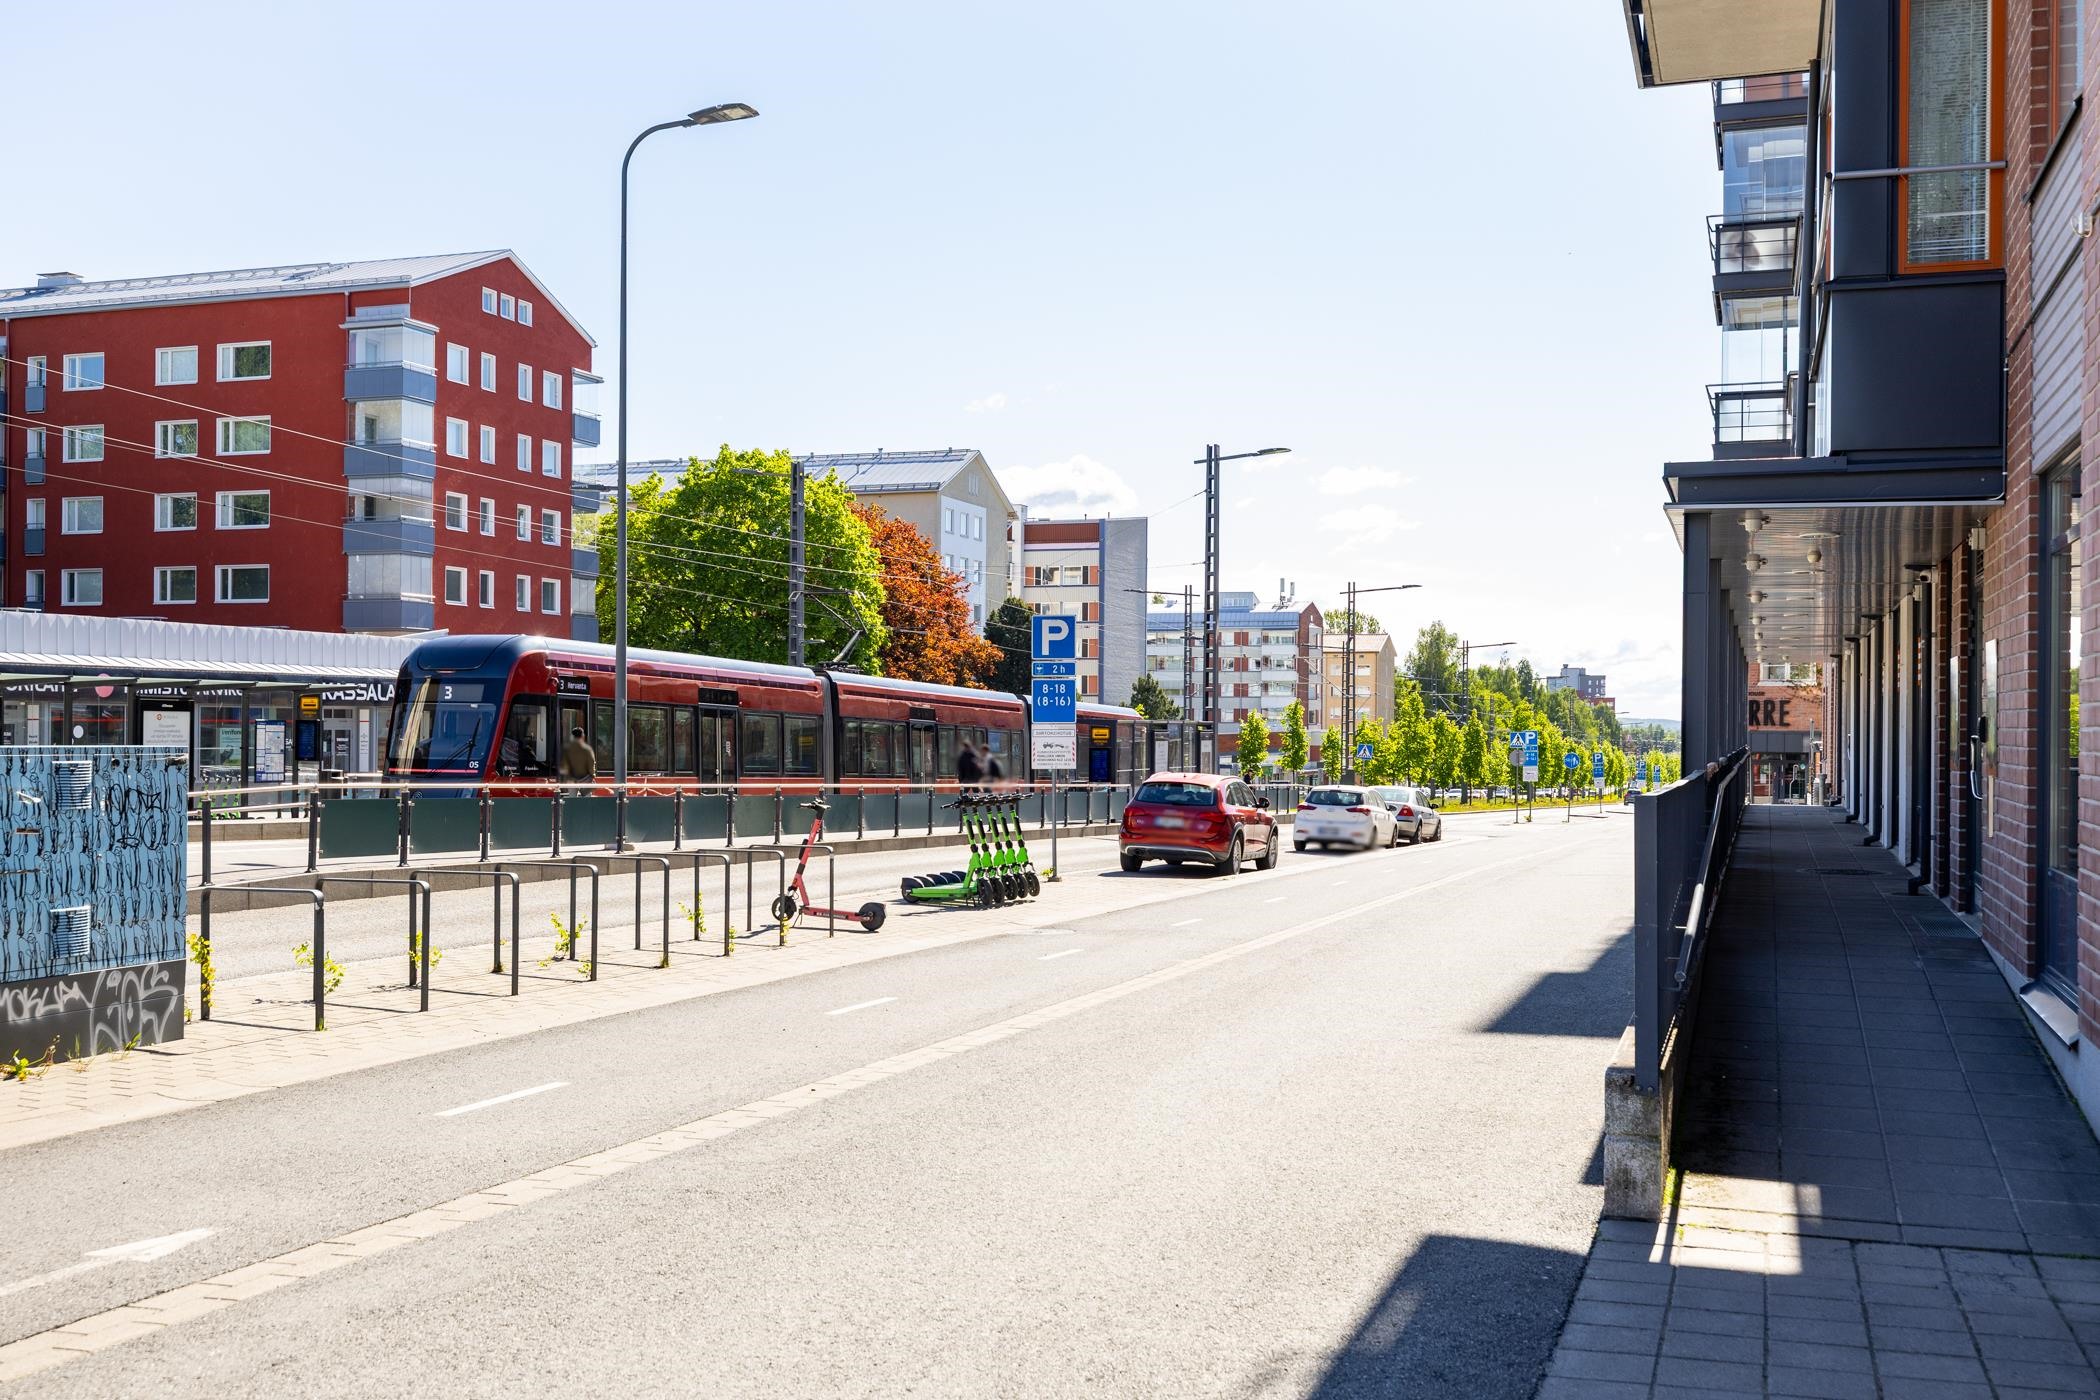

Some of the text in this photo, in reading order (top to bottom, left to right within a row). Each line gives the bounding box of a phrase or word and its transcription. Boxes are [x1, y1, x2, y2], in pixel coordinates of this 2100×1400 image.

[1041, 619, 1070, 656] P
[1052, 664, 1066, 674] 2 h
[560, 680, 565, 690] 3
[1042, 683, 1066, 694] 8-18
[444, 685, 453, 700] 3
[1037, 696, 1071, 706] (8-16)
[1525, 731, 1536, 744] P
[469, 761, 479, 769] 05
